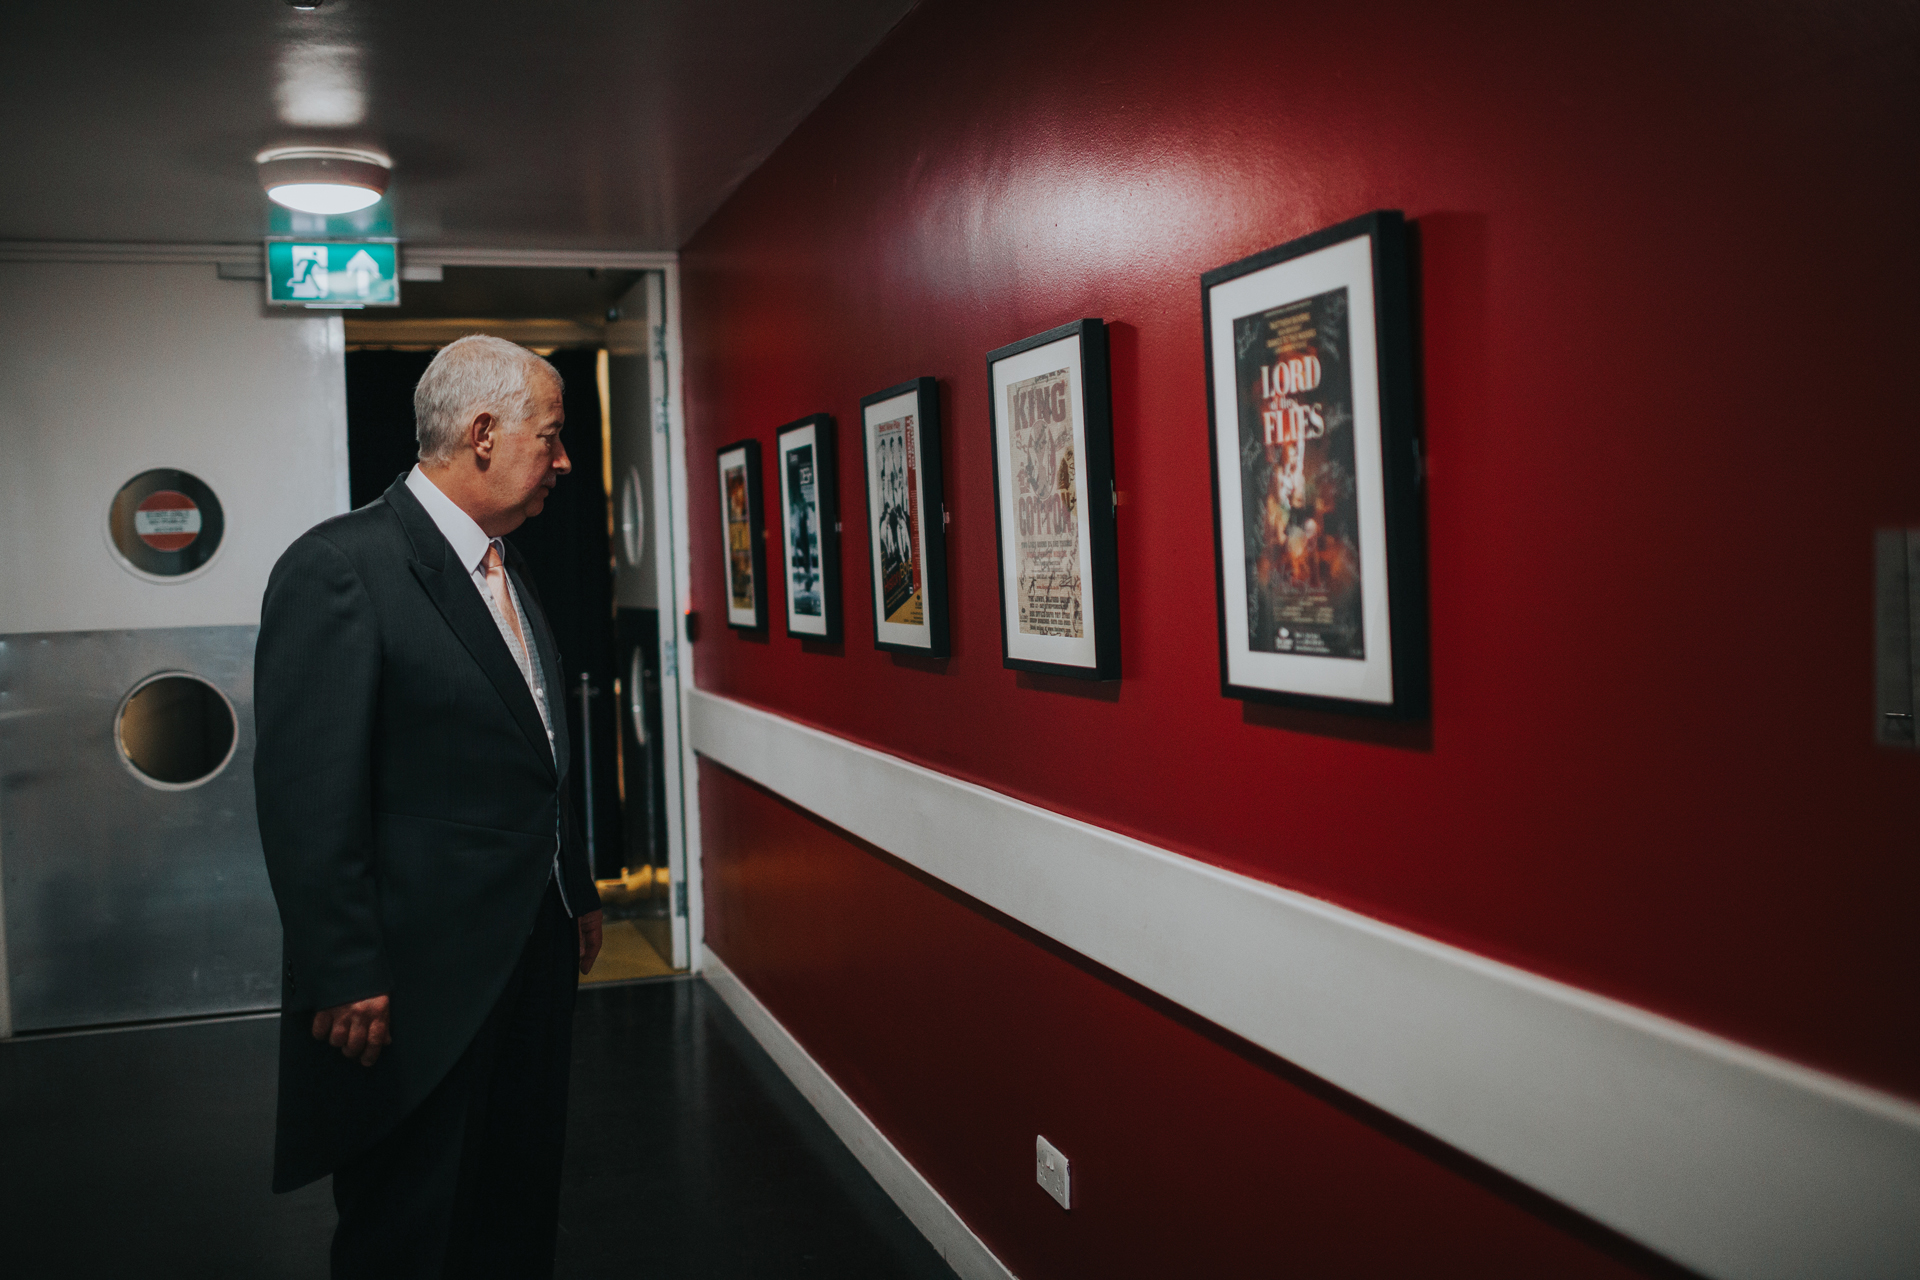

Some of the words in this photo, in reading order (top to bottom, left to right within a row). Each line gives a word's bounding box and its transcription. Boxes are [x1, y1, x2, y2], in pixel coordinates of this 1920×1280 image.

[1260, 355, 1322, 399] LORD
[1013, 381, 1067, 432] KING
[1262, 402, 1325, 446] FLIES
[1018, 492, 1072, 537] COTTON
